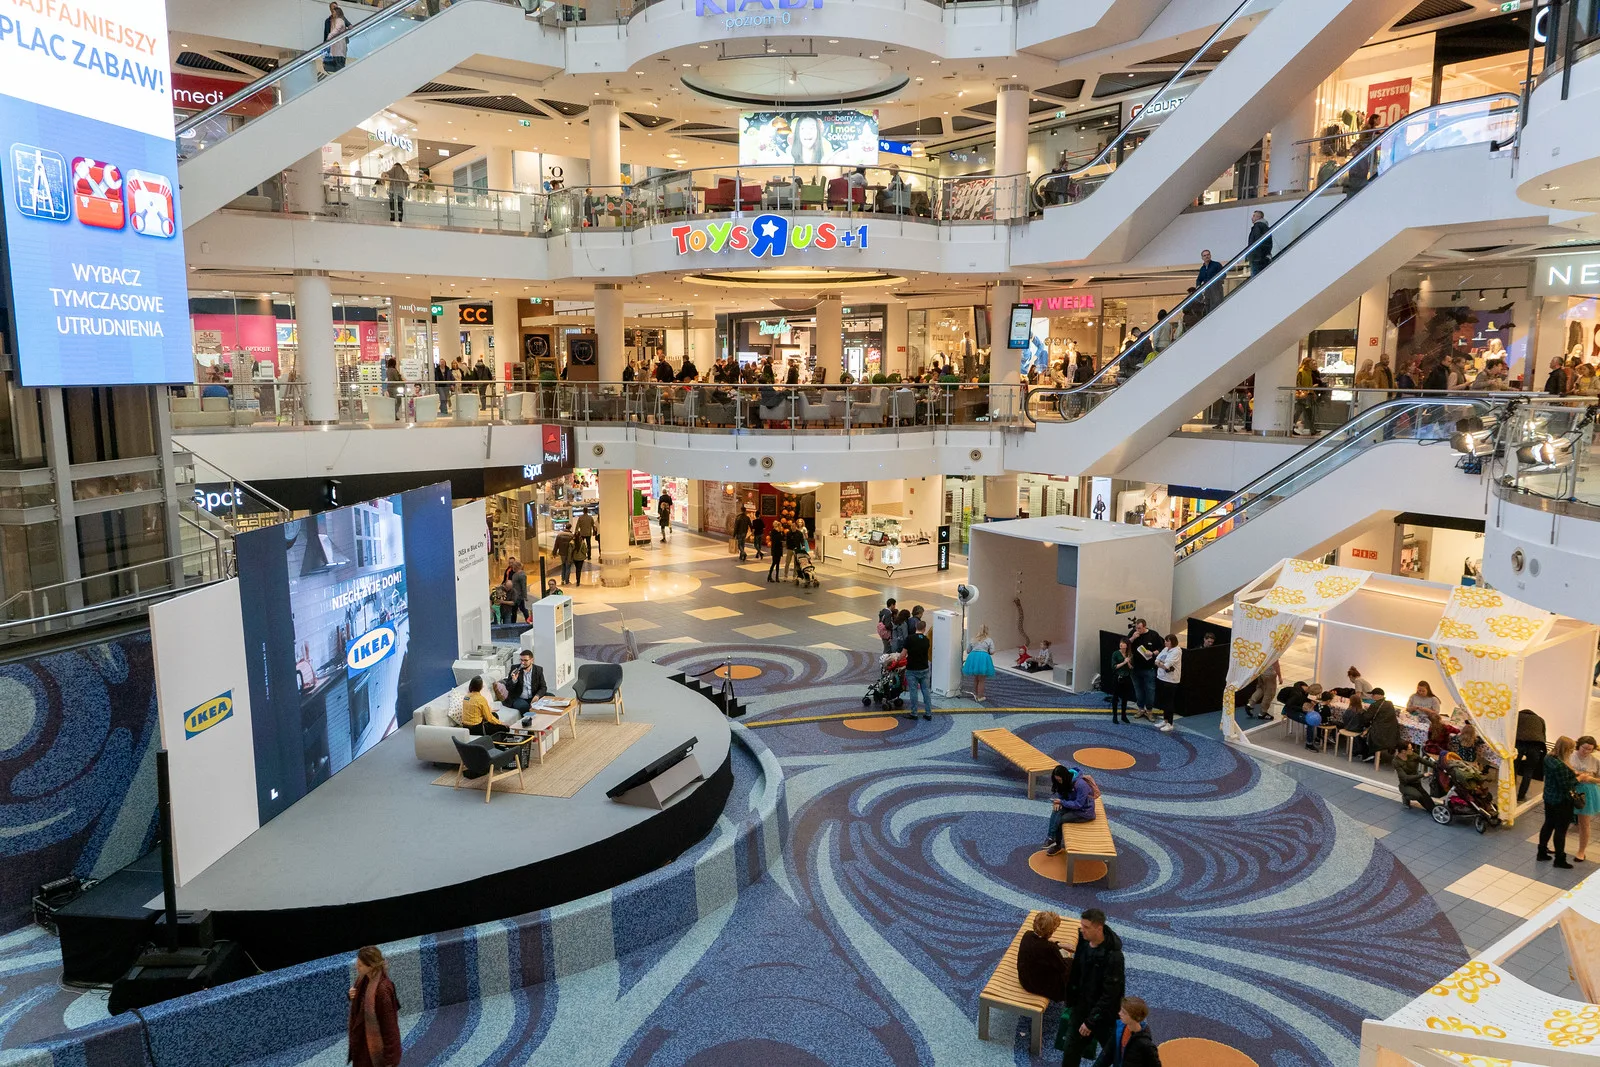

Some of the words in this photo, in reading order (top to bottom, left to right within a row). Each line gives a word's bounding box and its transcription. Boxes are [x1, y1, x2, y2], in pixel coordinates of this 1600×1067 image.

[726, 15, 776, 31] poziom
[782, 11, 791, 24] 0
[72, 39, 165, 94] ZABAW!
[1369, 84, 1410, 100] WSZYSTKO
[841, 224, 869, 249] +1
[71, 262, 142, 287] WYBACZ
[48, 287, 165, 313] TYMCZASOWE
[56, 315, 165, 338] UTRUDNIENIA
[382, 570, 403, 590] DOM!
[353, 633, 391, 664] IKEA
[191, 701, 228, 729] IKEA
